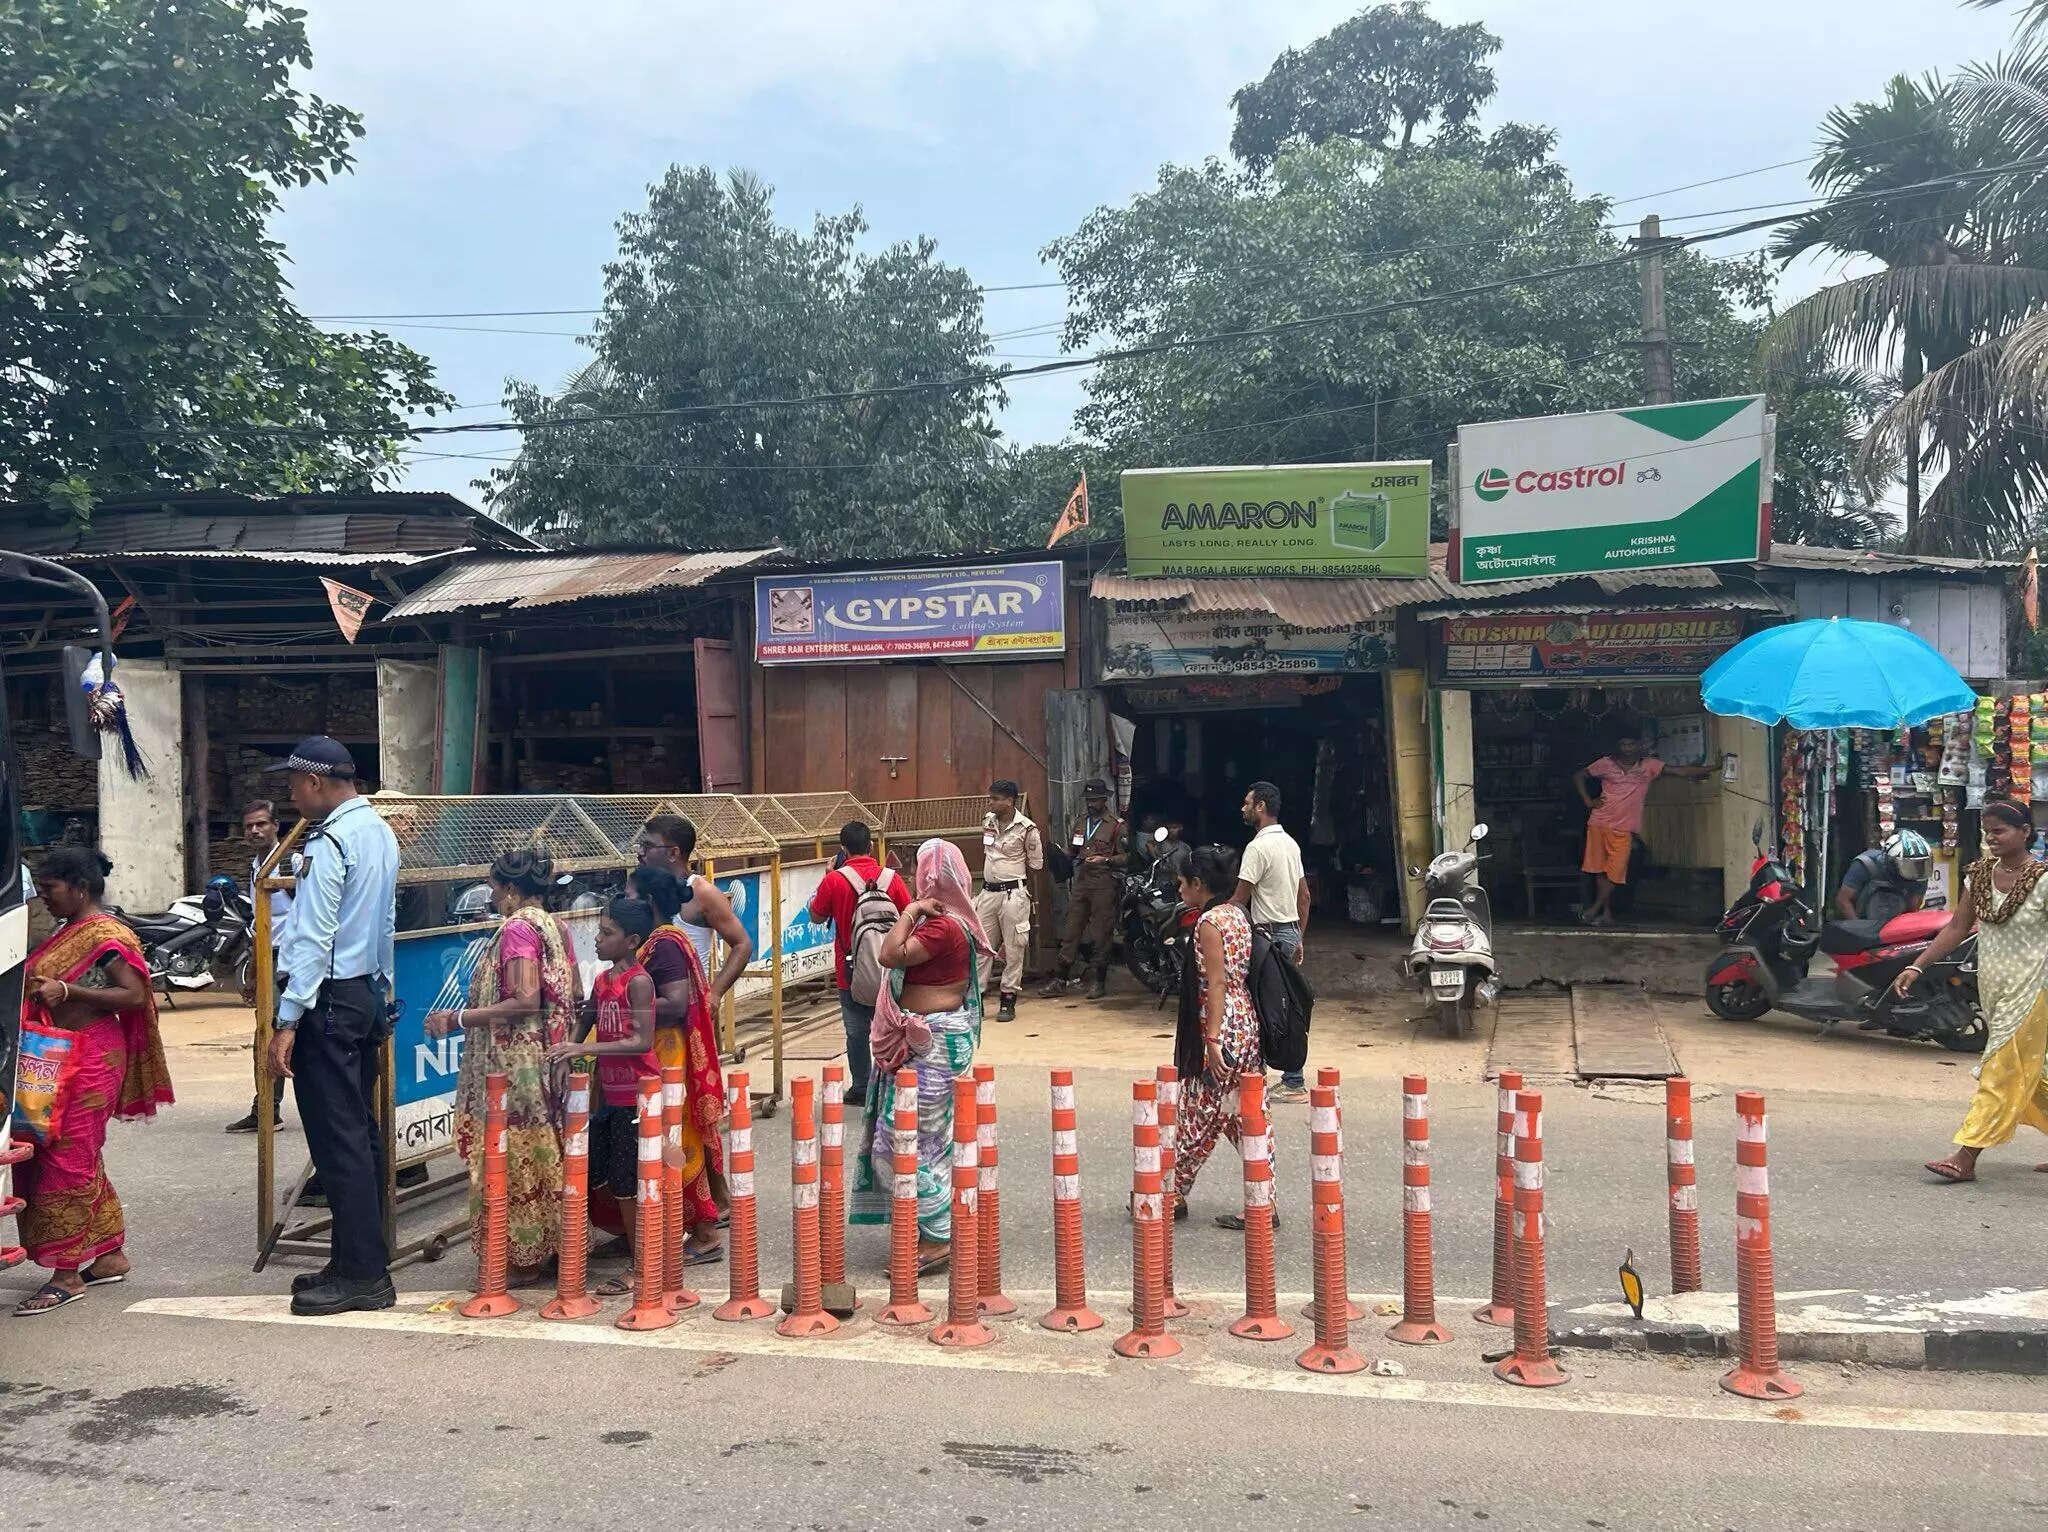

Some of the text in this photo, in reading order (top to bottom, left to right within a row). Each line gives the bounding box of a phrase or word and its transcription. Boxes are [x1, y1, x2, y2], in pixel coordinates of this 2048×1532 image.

[1514, 462, 1626, 494] Castrol
[1160, 500, 1317, 531] AMARON
[1162, 539, 1196, 548] LASTS
[1237, 538, 1278, 548] REALLY
[1282, 537, 1318, 547] LONG.
[1630, 535, 1676, 547] KRISHNA
[1604, 545, 1676, 559] AUTOMOBILES
[1162, 565, 1183, 575] MAA
[1185, 565, 1227, 575] BAGALA
[1229, 565, 1254, 575] BIKE
[1321, 564, 1381, 574] 9854325896
[845, 591, 1024, 622] GYPSTAR
[988, 619, 1024, 631] System
[1449, 619, 1736, 641] KRISHNA AUTOMOBILES
[763, 645, 787, 655] SHREE
[788, 645, 804, 655] RAM
[1234, 660, 1317, 671] 98543-25896
